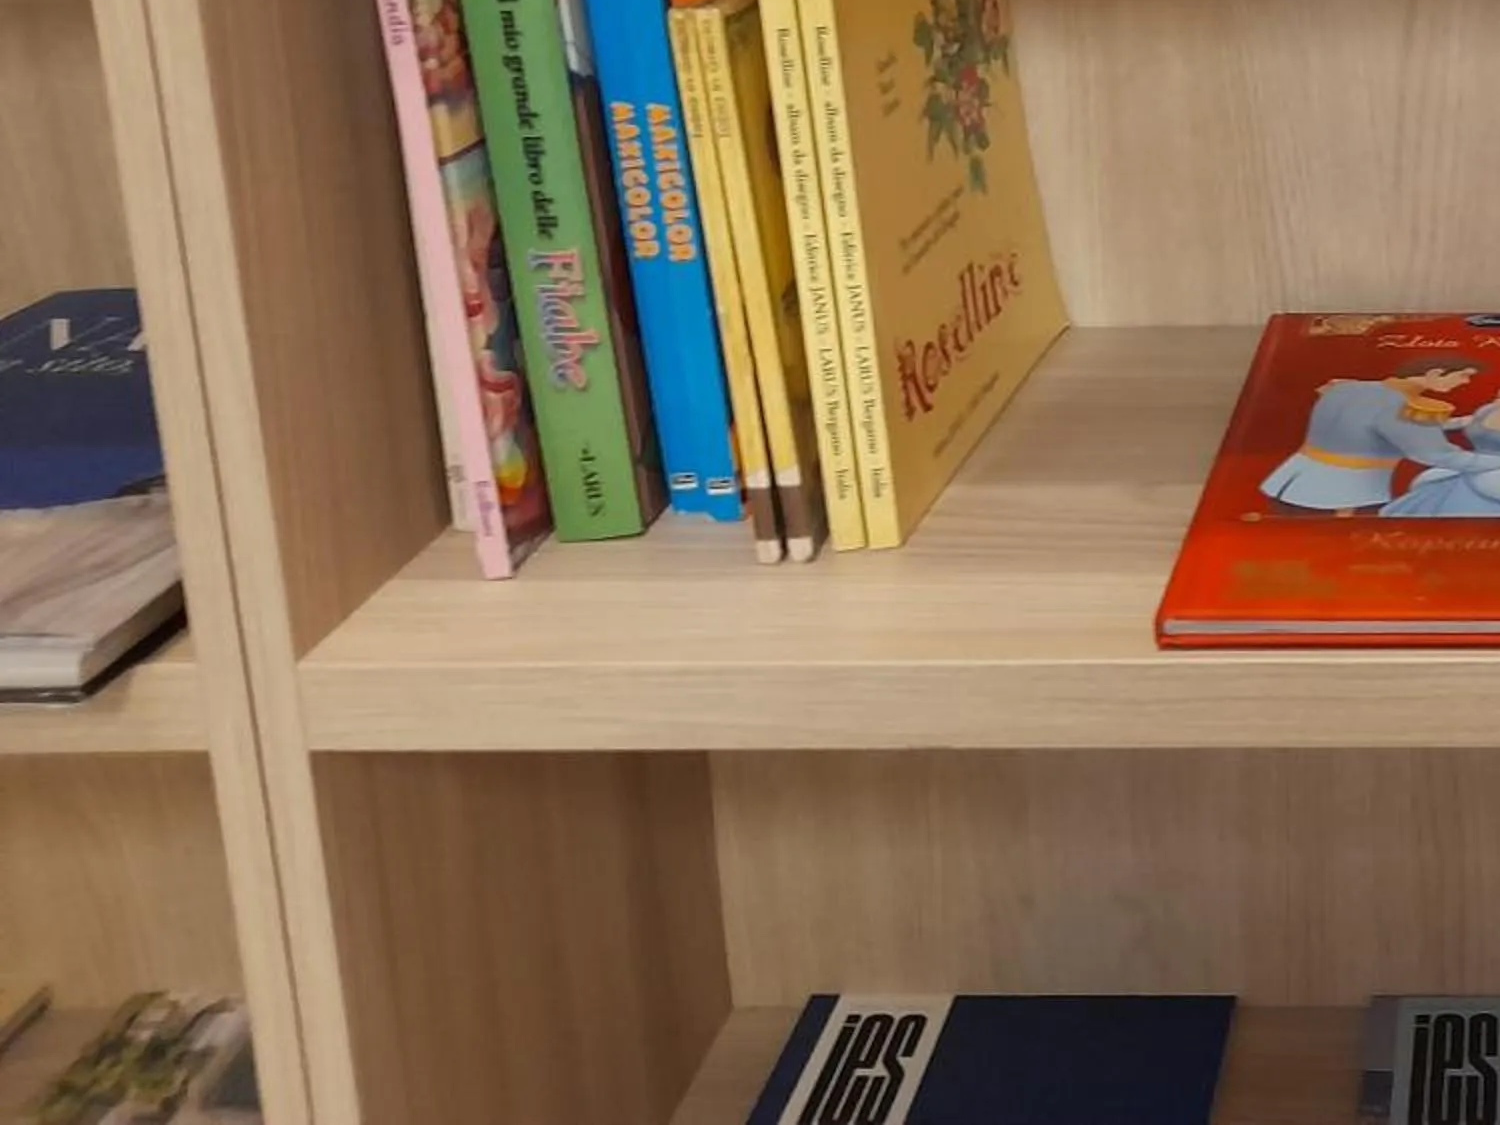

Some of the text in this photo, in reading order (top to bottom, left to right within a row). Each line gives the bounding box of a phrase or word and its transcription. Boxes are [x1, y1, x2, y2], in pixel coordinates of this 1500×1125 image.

[502, 9, 524, 49] mio
[503, 53, 538, 132] grande
[783, 103, 805, 144] album
[821, 100, 843, 141] album
[521, 135, 546, 183] libro
[790, 147, 805, 164] da
[828, 144, 844, 162] da
[530, 189, 560, 240] delle
[528, 247, 600, 392] Fiabe
[895, 251, 1023, 421] Roselline
